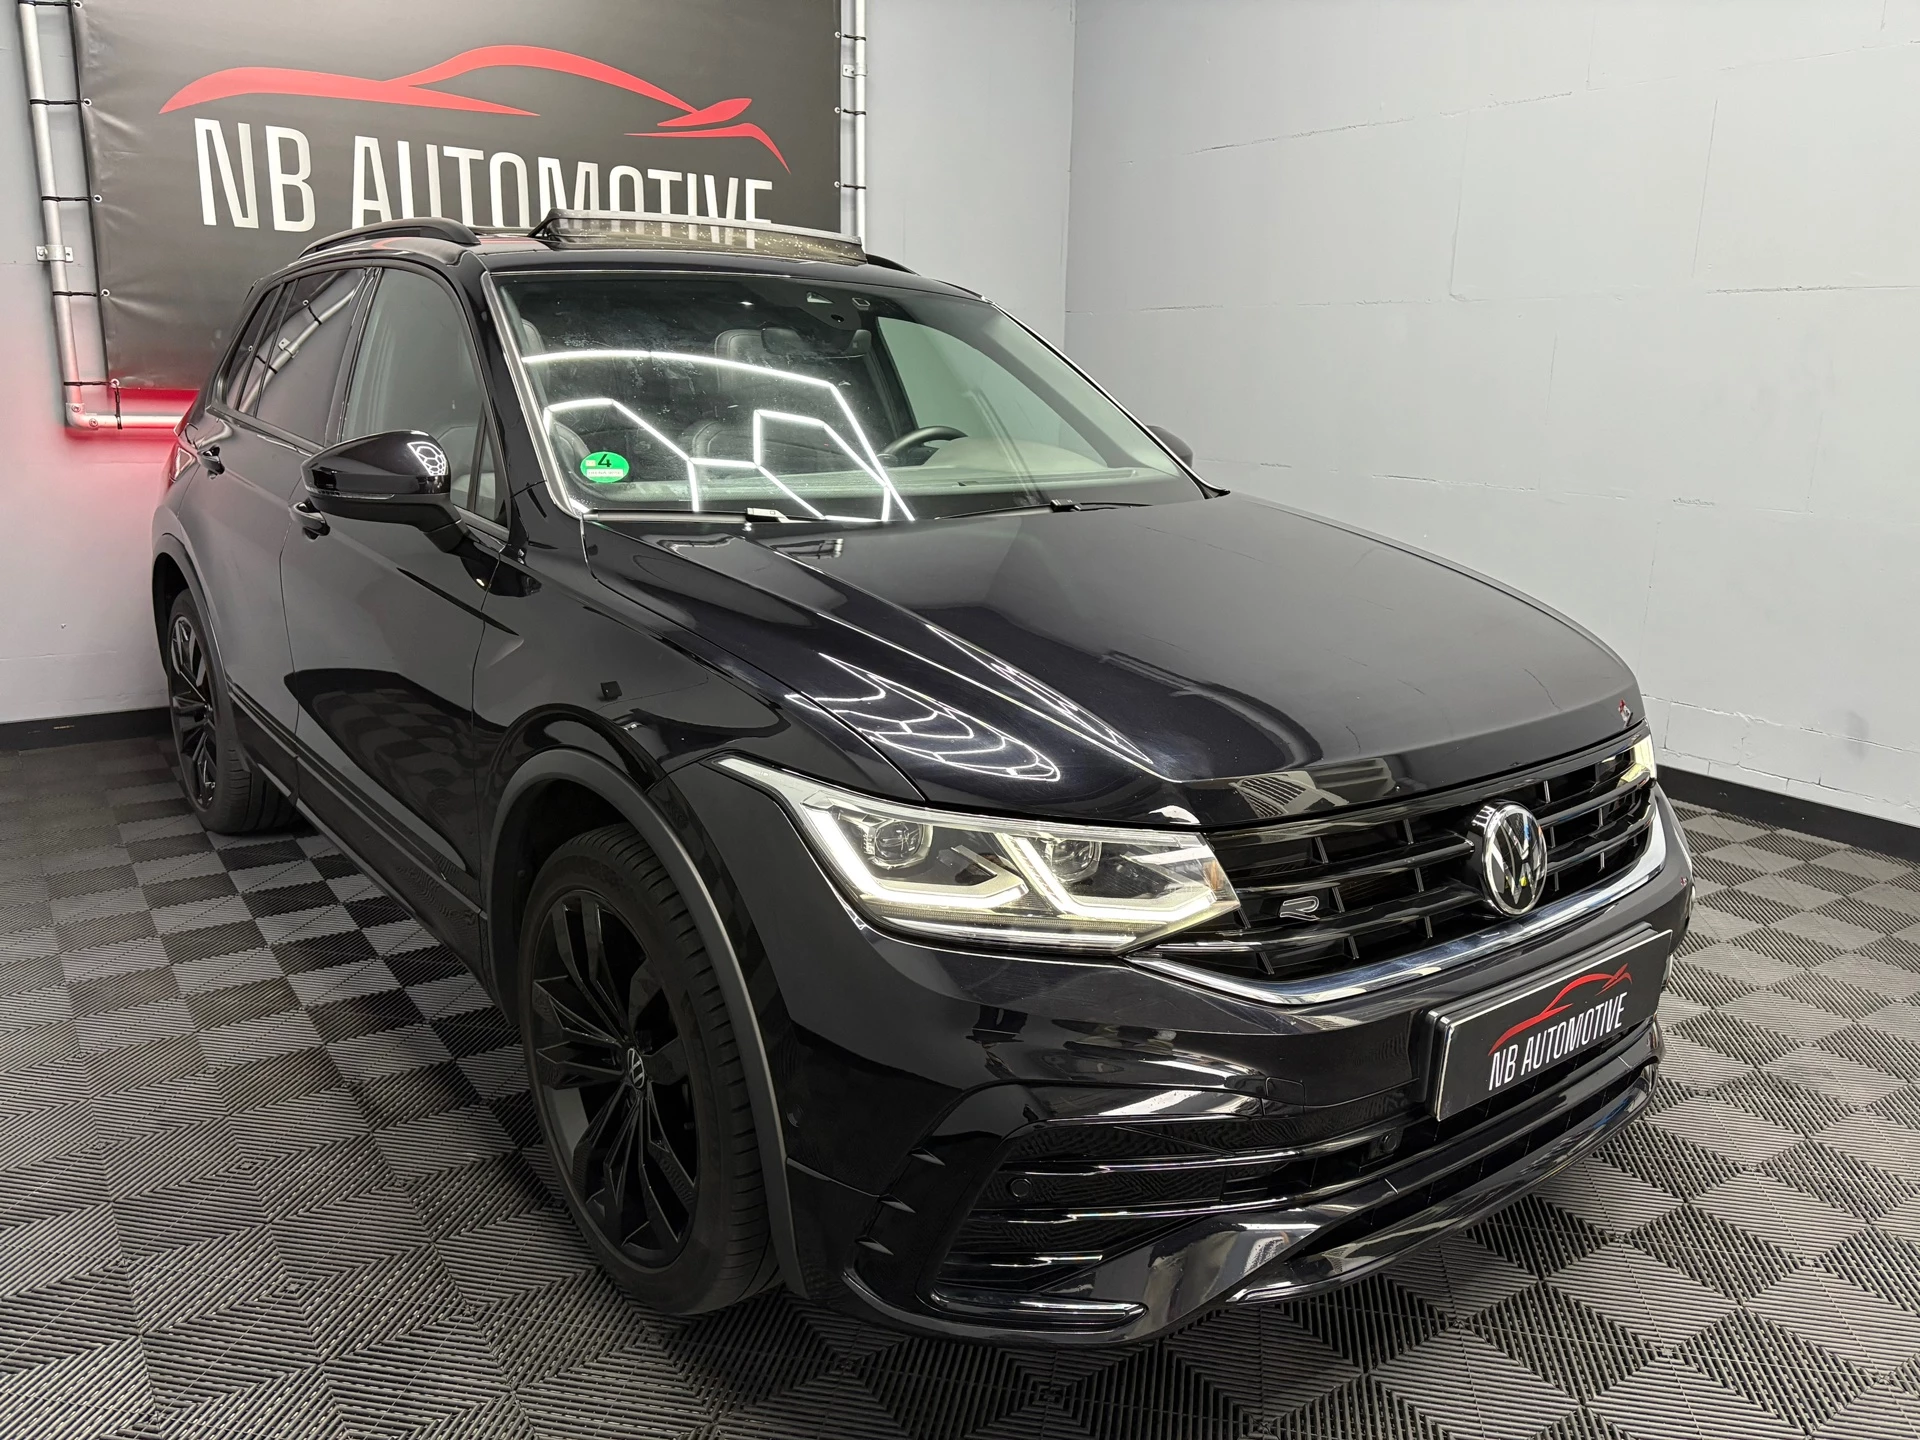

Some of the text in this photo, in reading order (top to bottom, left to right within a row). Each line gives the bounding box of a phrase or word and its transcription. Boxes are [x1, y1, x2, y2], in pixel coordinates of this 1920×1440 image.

[193, 117, 774, 246] NB AUTOMOTIVE
[597, 453, 612, 468] 4
[1488, 992, 1628, 1091] NB AUTOMOTIVE
